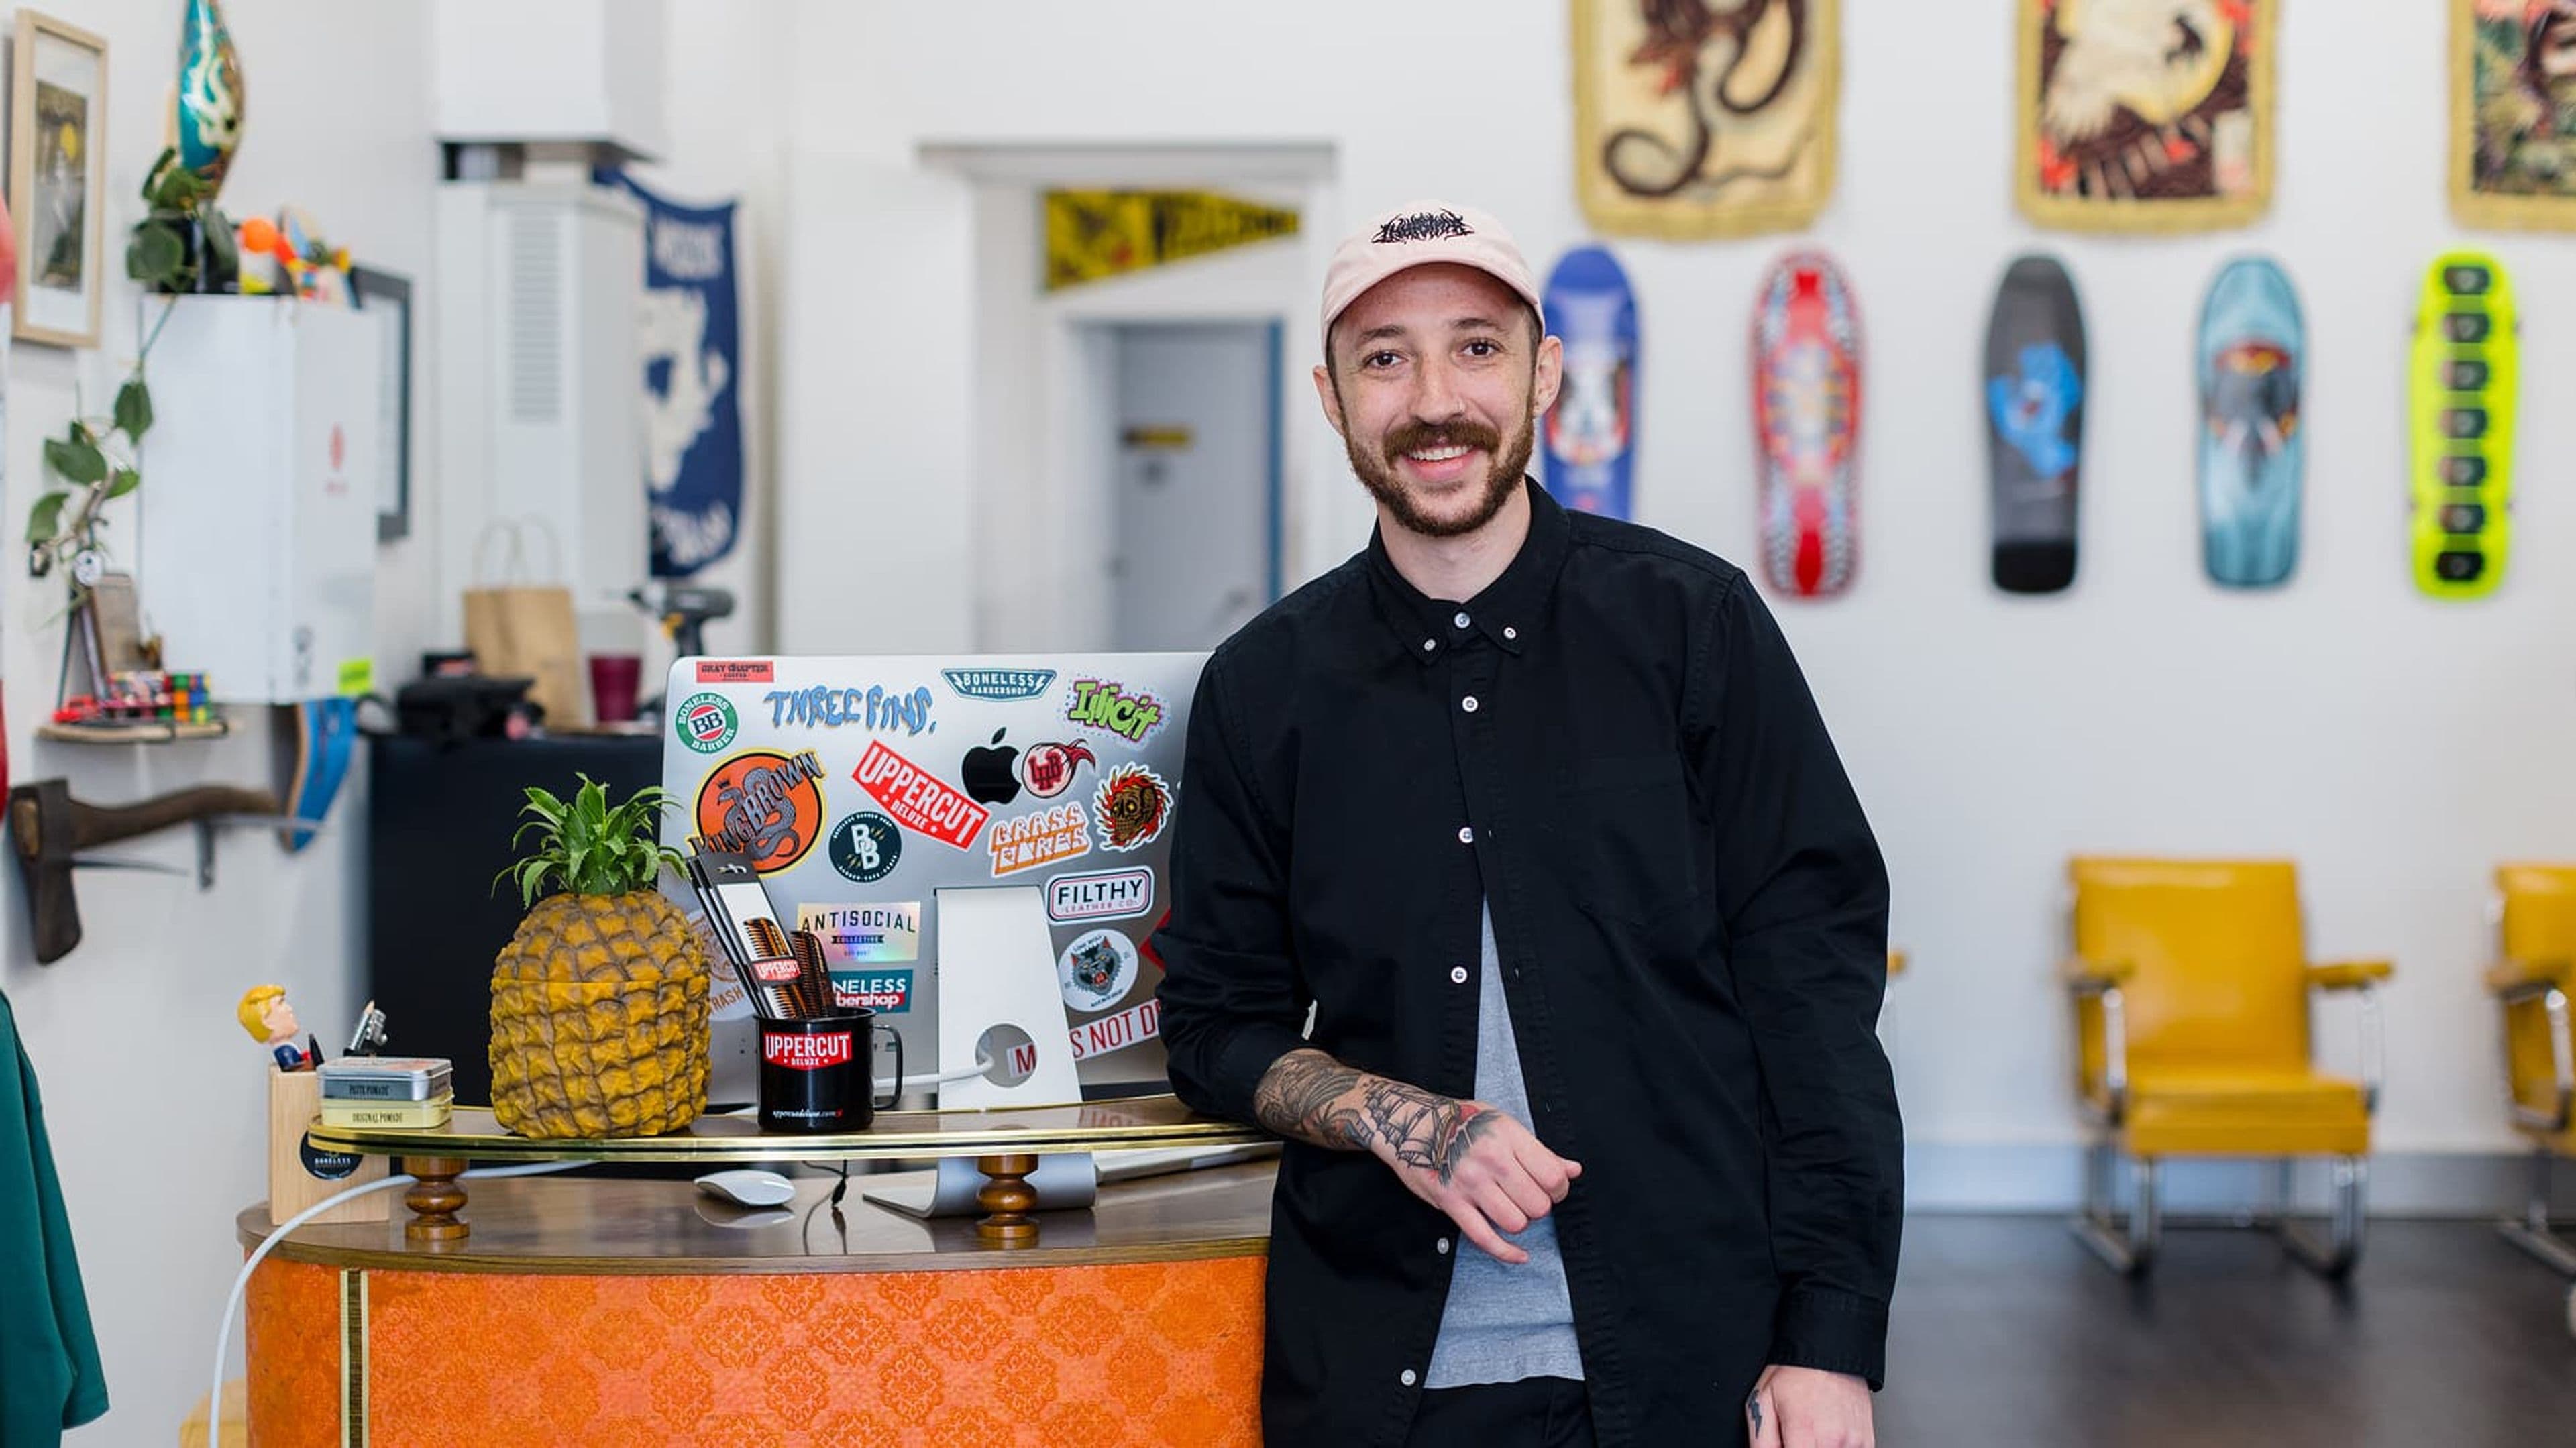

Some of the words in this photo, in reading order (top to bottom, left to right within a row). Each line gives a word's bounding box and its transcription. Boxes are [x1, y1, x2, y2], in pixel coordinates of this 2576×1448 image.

[963, 673, 1034, 687] BONELESS
[678, 695, 729, 724] BONELESS
[763, 684, 863, 729] THREE
[691, 712, 723, 735] BB
[690, 728, 735, 752] BARBER
[858, 746, 985, 844] UPPERCUT
[890, 799, 929, 830] DELUXE
[1058, 879, 1143, 905] FILTHY
[802, 911, 916, 933] ANTISOCIAL
[832, 978, 906, 995] NELESS
[835, 991, 900, 1011] bershop
[1089, 1011, 1133, 1053] NOT
[765, 1034, 850, 1060] UPPERCUT
[791, 1058, 820, 1066] DELUXE
